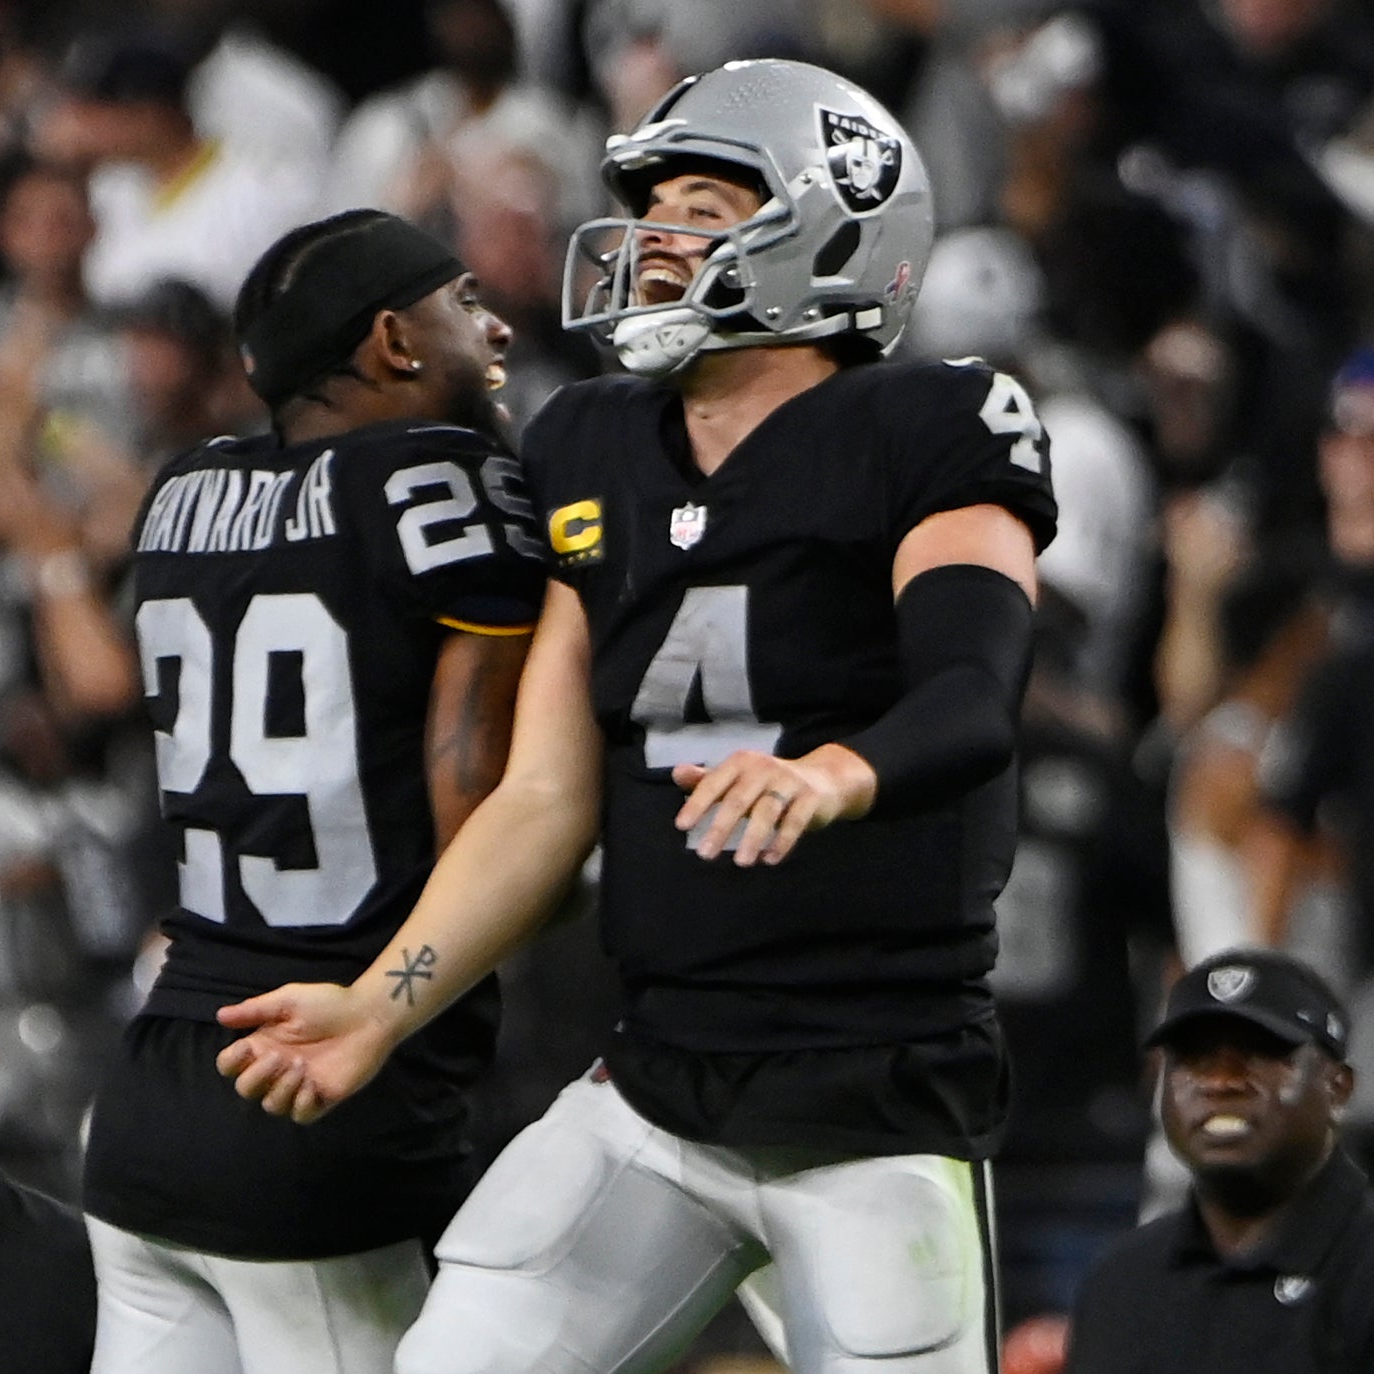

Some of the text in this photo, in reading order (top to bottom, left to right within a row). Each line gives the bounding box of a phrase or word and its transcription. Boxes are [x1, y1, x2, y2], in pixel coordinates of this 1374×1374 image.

[978, 372, 1042, 473] 4
[137, 449, 336, 553] HAYWARD JR
[549, 500, 603, 554] C
[136, 593, 378, 928] 29
[630, 584, 784, 850] 4
